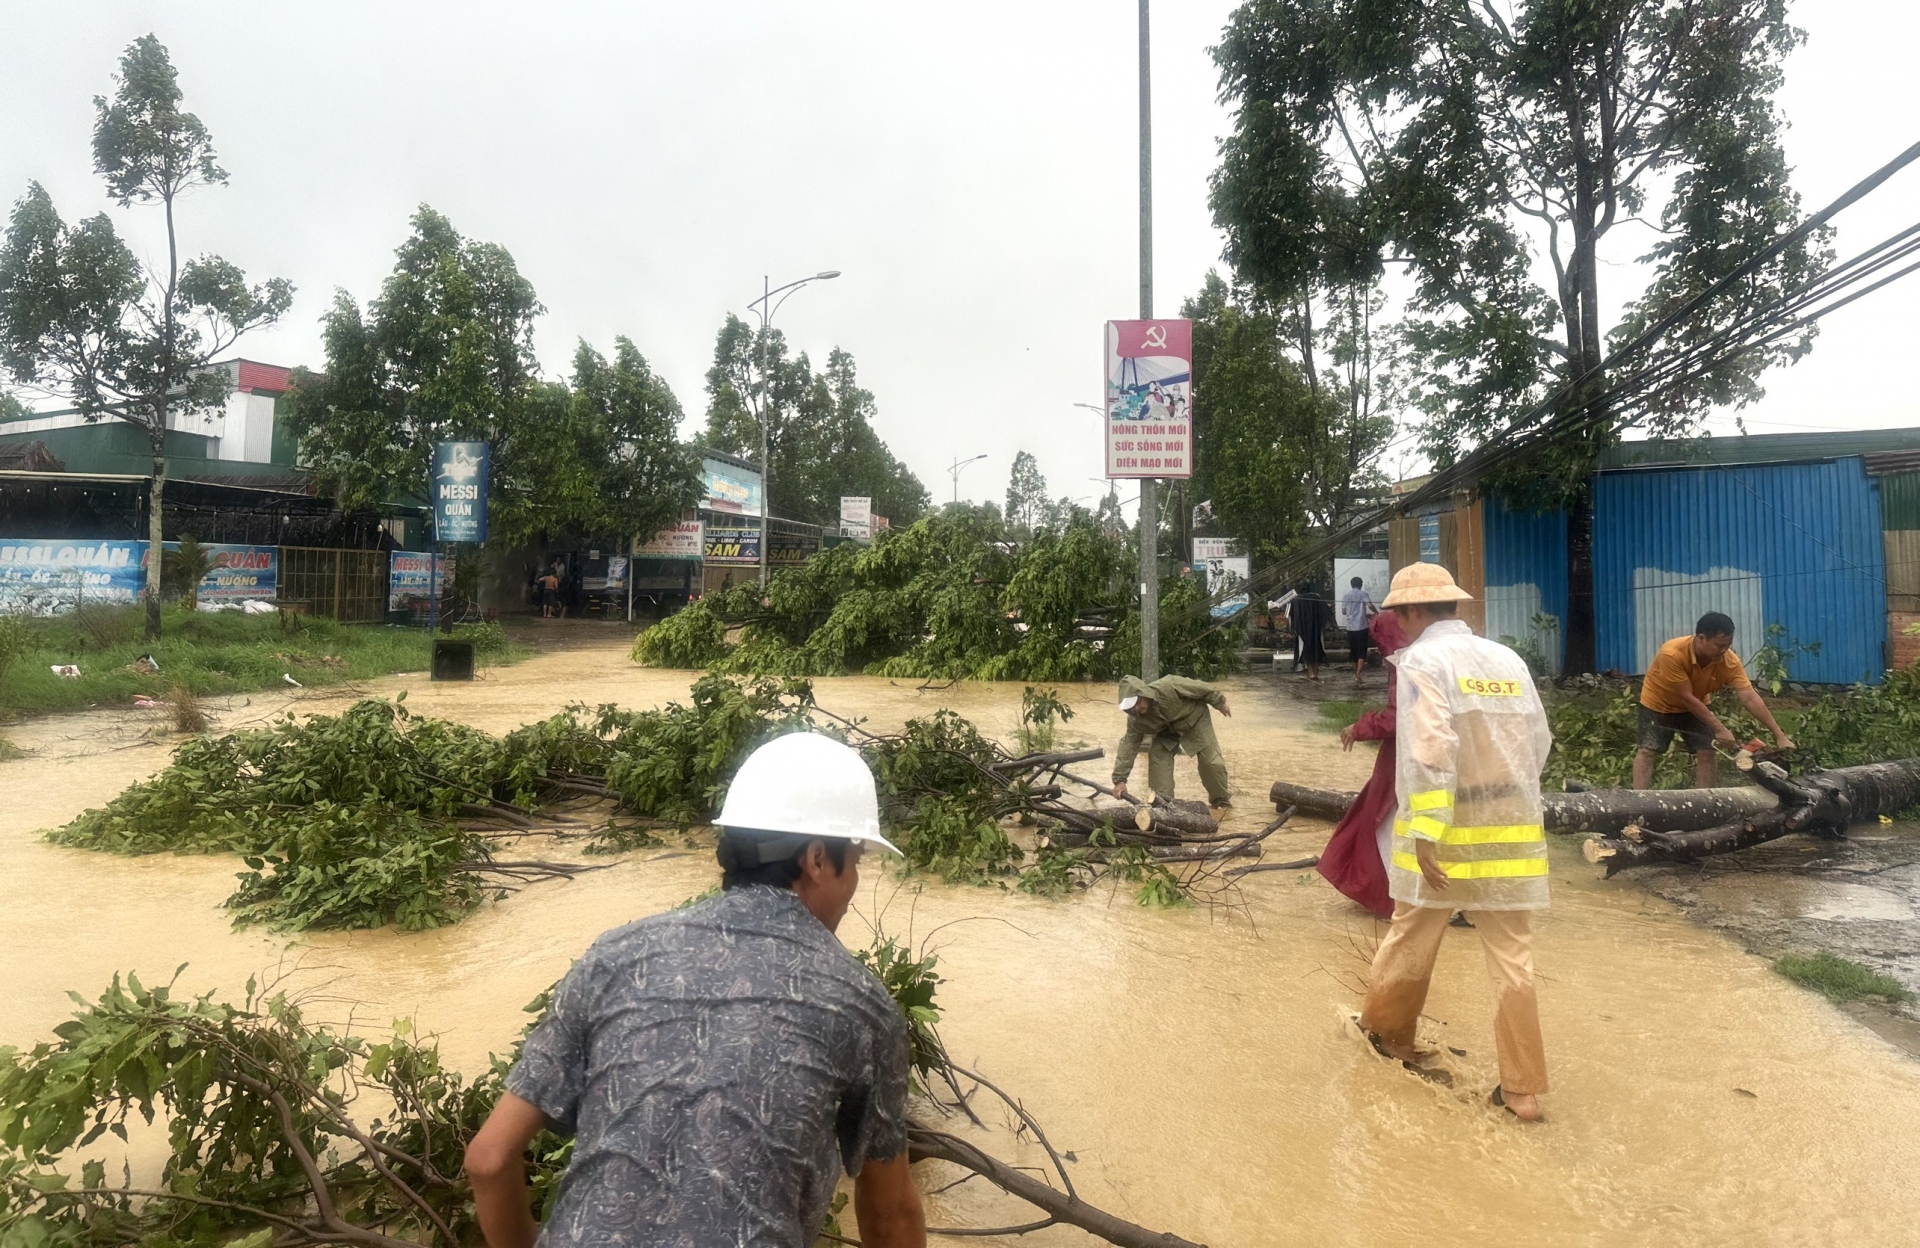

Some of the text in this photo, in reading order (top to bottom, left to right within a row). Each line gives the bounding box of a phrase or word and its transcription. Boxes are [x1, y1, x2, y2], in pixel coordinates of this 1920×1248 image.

[1112, 423, 1187, 435] NÔNG THÔN MỚI
[1114, 439, 1184, 452] SỨC SỐNG MỚI
[1116, 456, 1183, 470] DIỆN MẠO MỚI
[440, 485, 478, 500] MESSI
[445, 502, 472, 516] QUÁN
[672, 533, 694, 541] NƯỚNG
[0, 546, 53, 566] ESSI
[57, 542, 130, 567] QUÁN
[704, 544, 741, 557] SAM
[768, 549, 801, 560] SAM
[1195, 546, 1225, 556] TRU
[214, 548, 272, 571] QUÁN
[394, 558, 422, 571] MESSI
[215, 574, 258, 587] NƯỚNG
